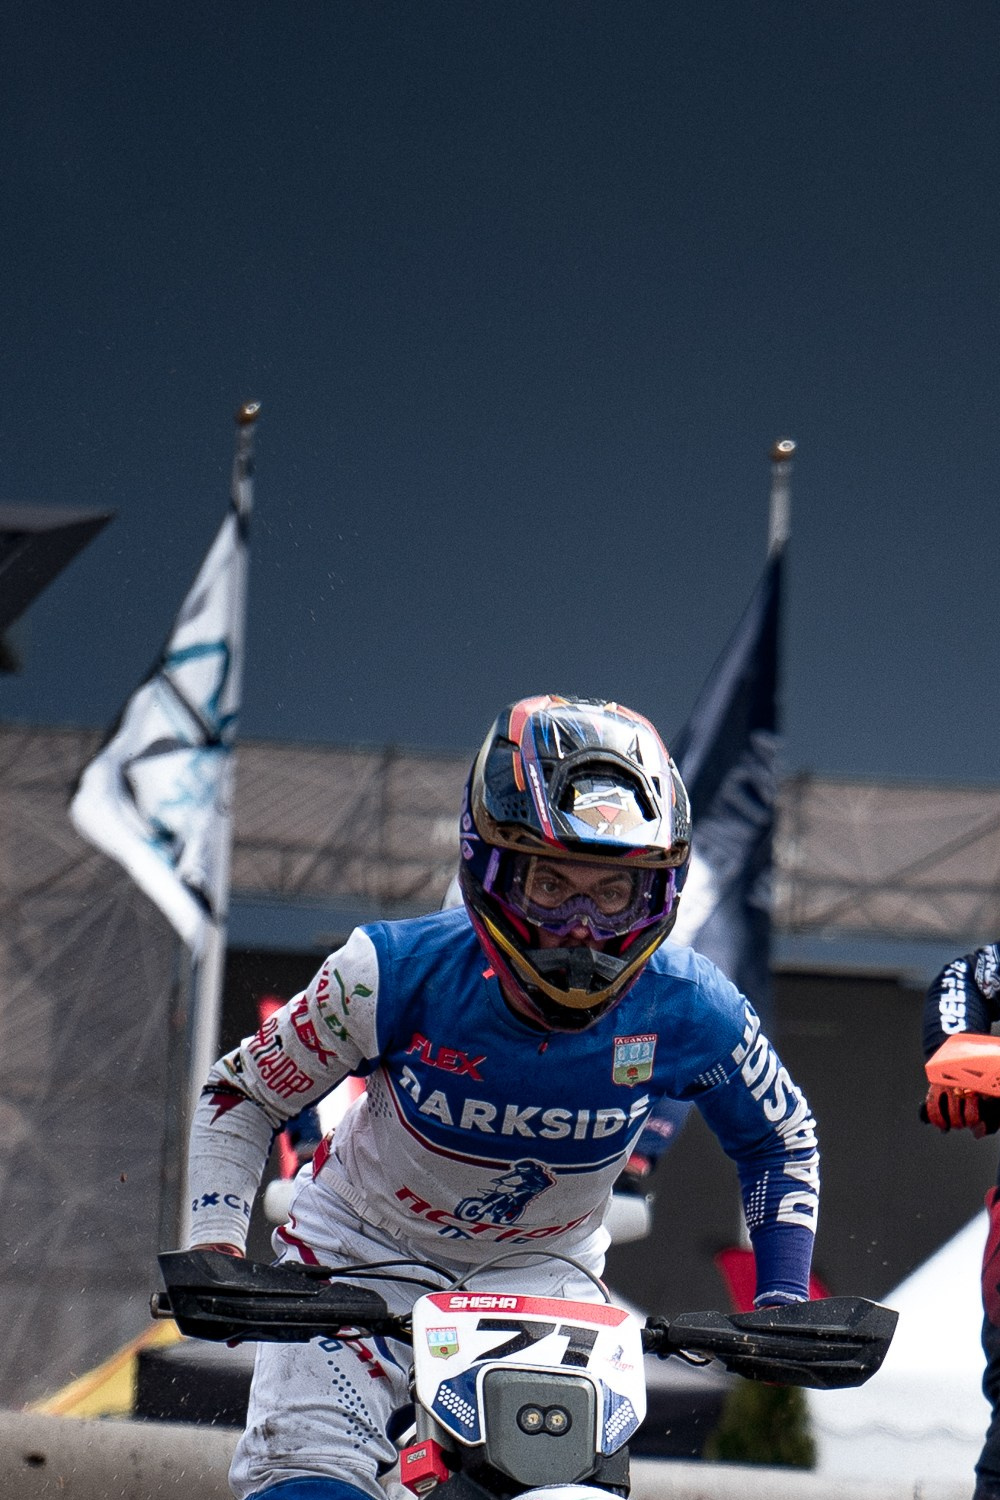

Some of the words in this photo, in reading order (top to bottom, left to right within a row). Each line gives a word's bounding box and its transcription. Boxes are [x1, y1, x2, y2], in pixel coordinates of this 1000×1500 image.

[316, 961, 349, 1042] ALLEX
[405, 1032, 487, 1081] FLEX
[449, 1296, 517, 1309] SHISHA
[470, 1318, 599, 1368] 71
